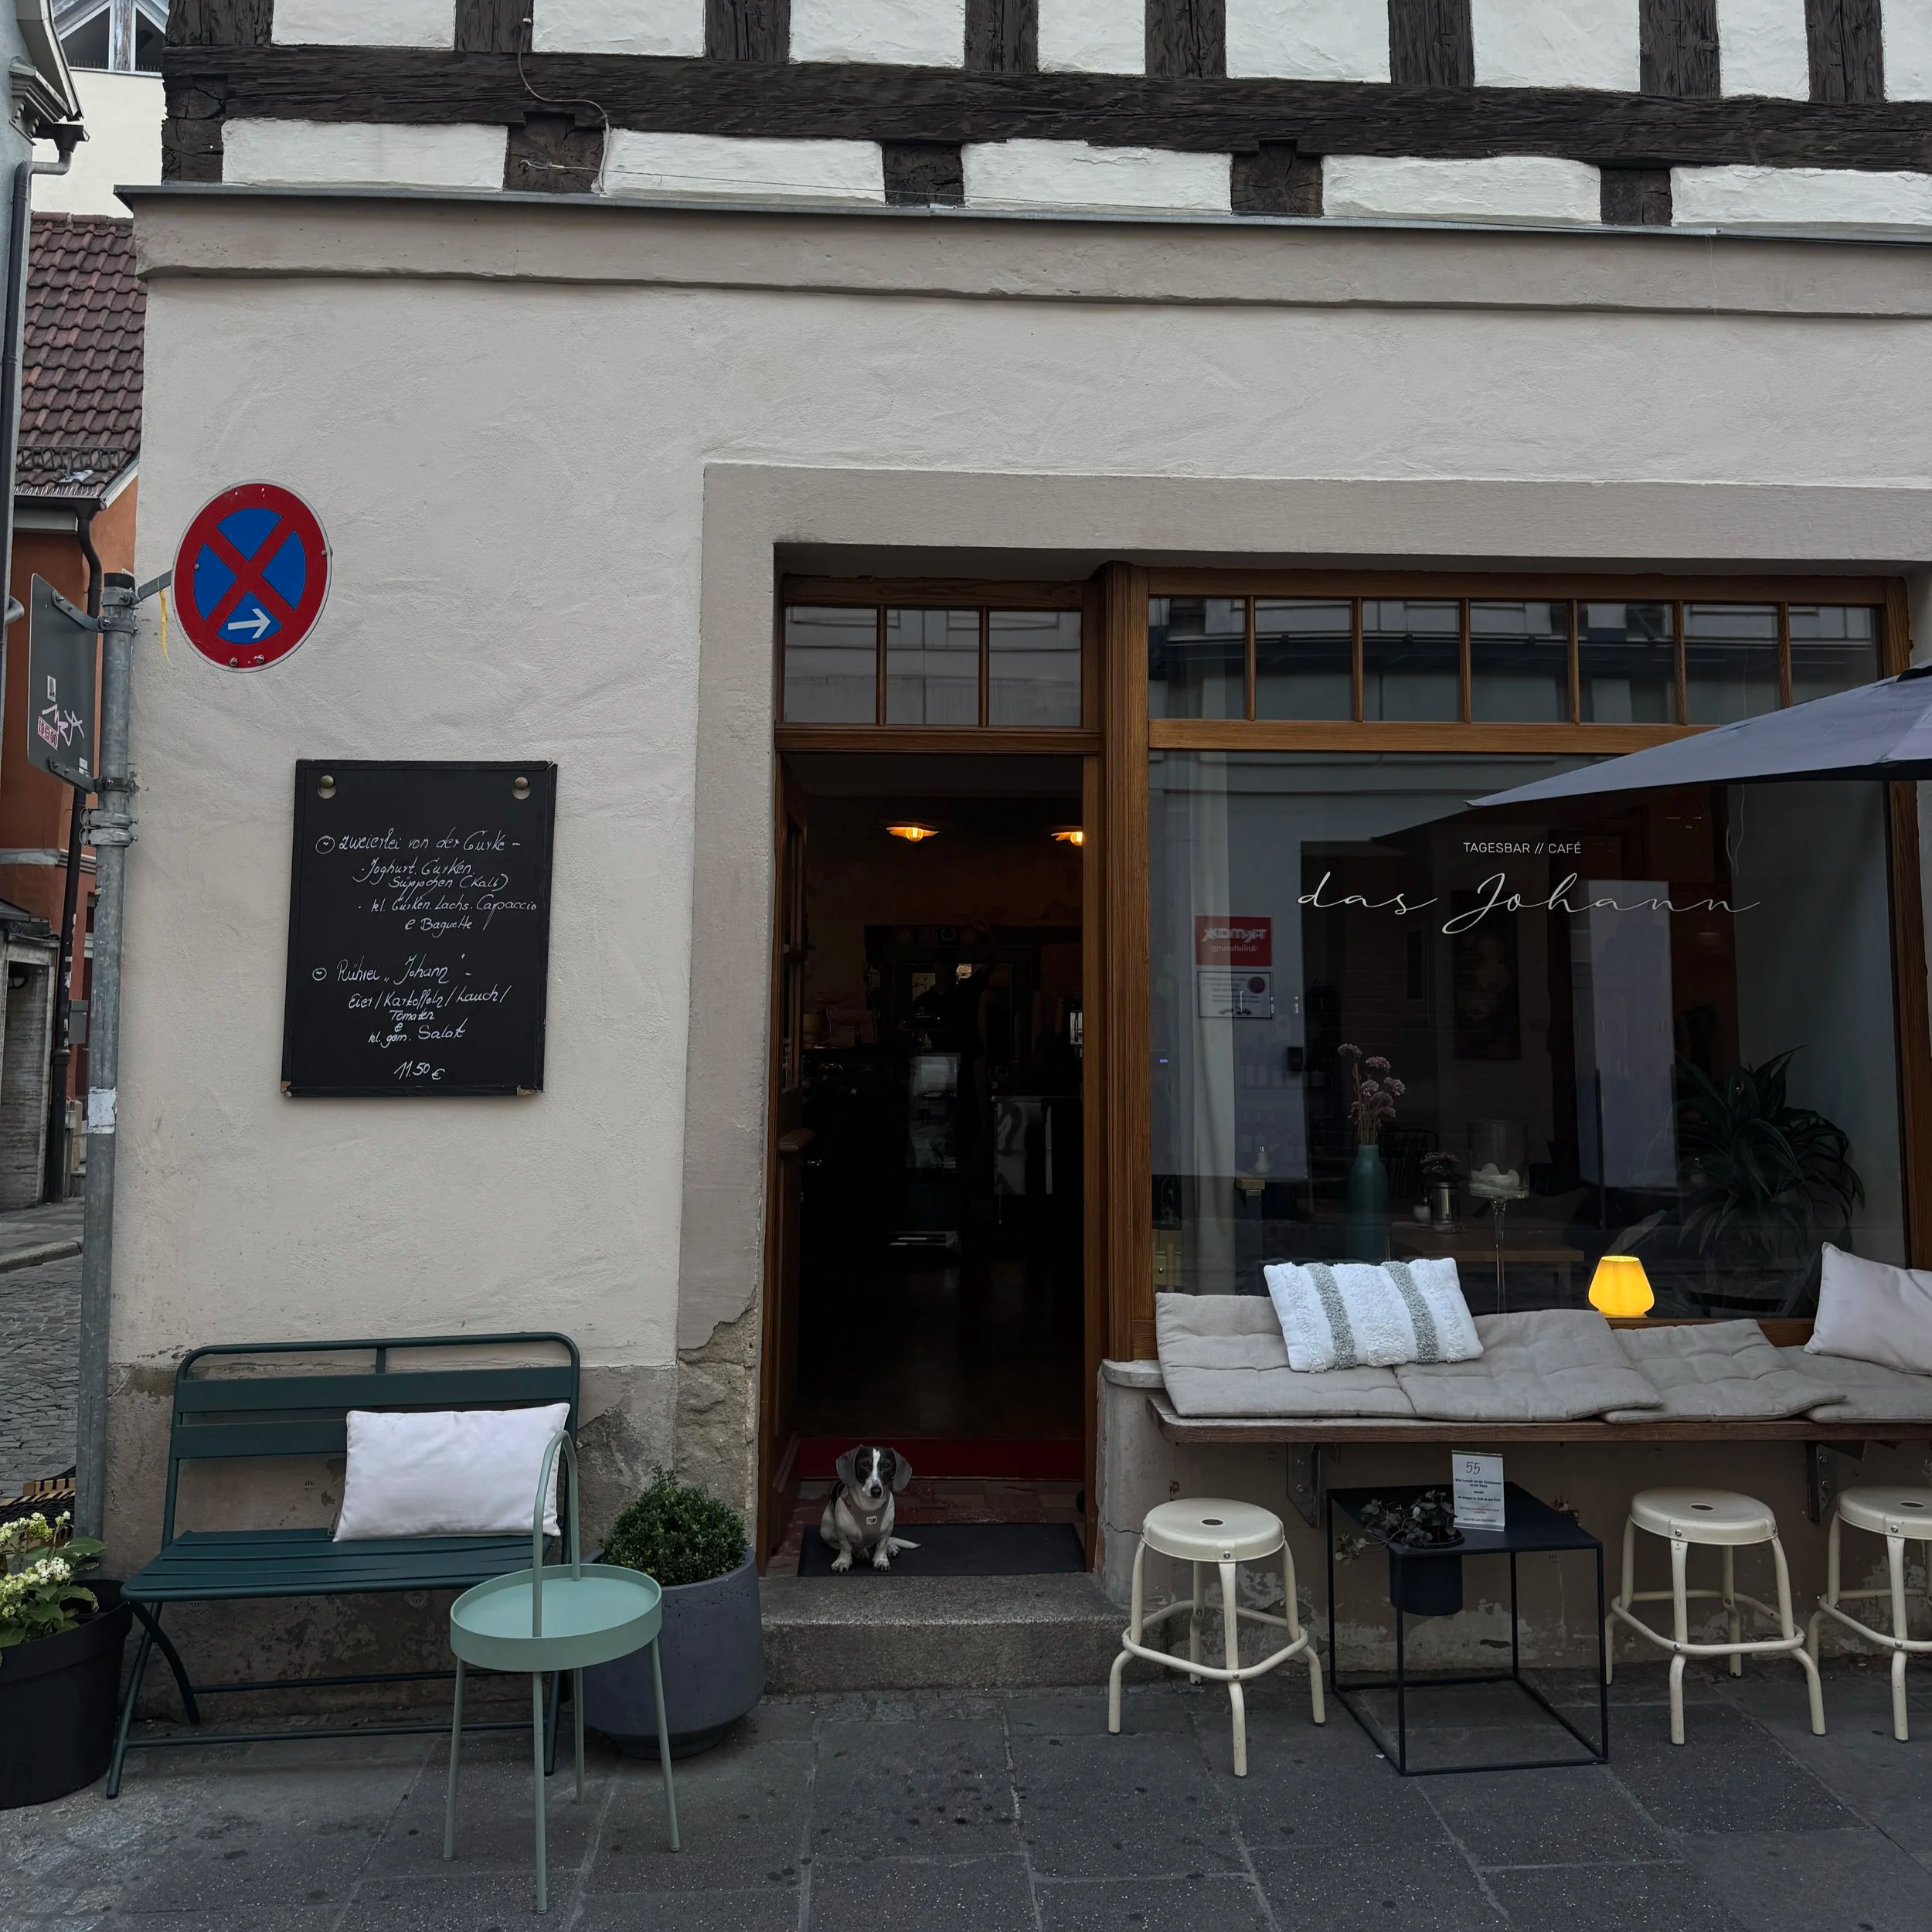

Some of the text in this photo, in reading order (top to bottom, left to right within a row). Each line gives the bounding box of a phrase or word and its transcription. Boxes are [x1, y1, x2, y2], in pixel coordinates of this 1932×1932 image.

[408, 838, 429, 849] von
[436, 826, 460, 849] der
[464, 830, 505, 851] Gurke
[1463, 842, 1530, 852] TAGESBAR
[1548, 842, 1581, 854] CAFÉ
[1298, 872, 1760, 934] das Johann
[420, 915, 473, 938] Baguette
[389, 1008, 435, 1021] Tomaten
[418, 1018, 468, 1039] Salat
[1465, 1461, 1481, 1475] 55
